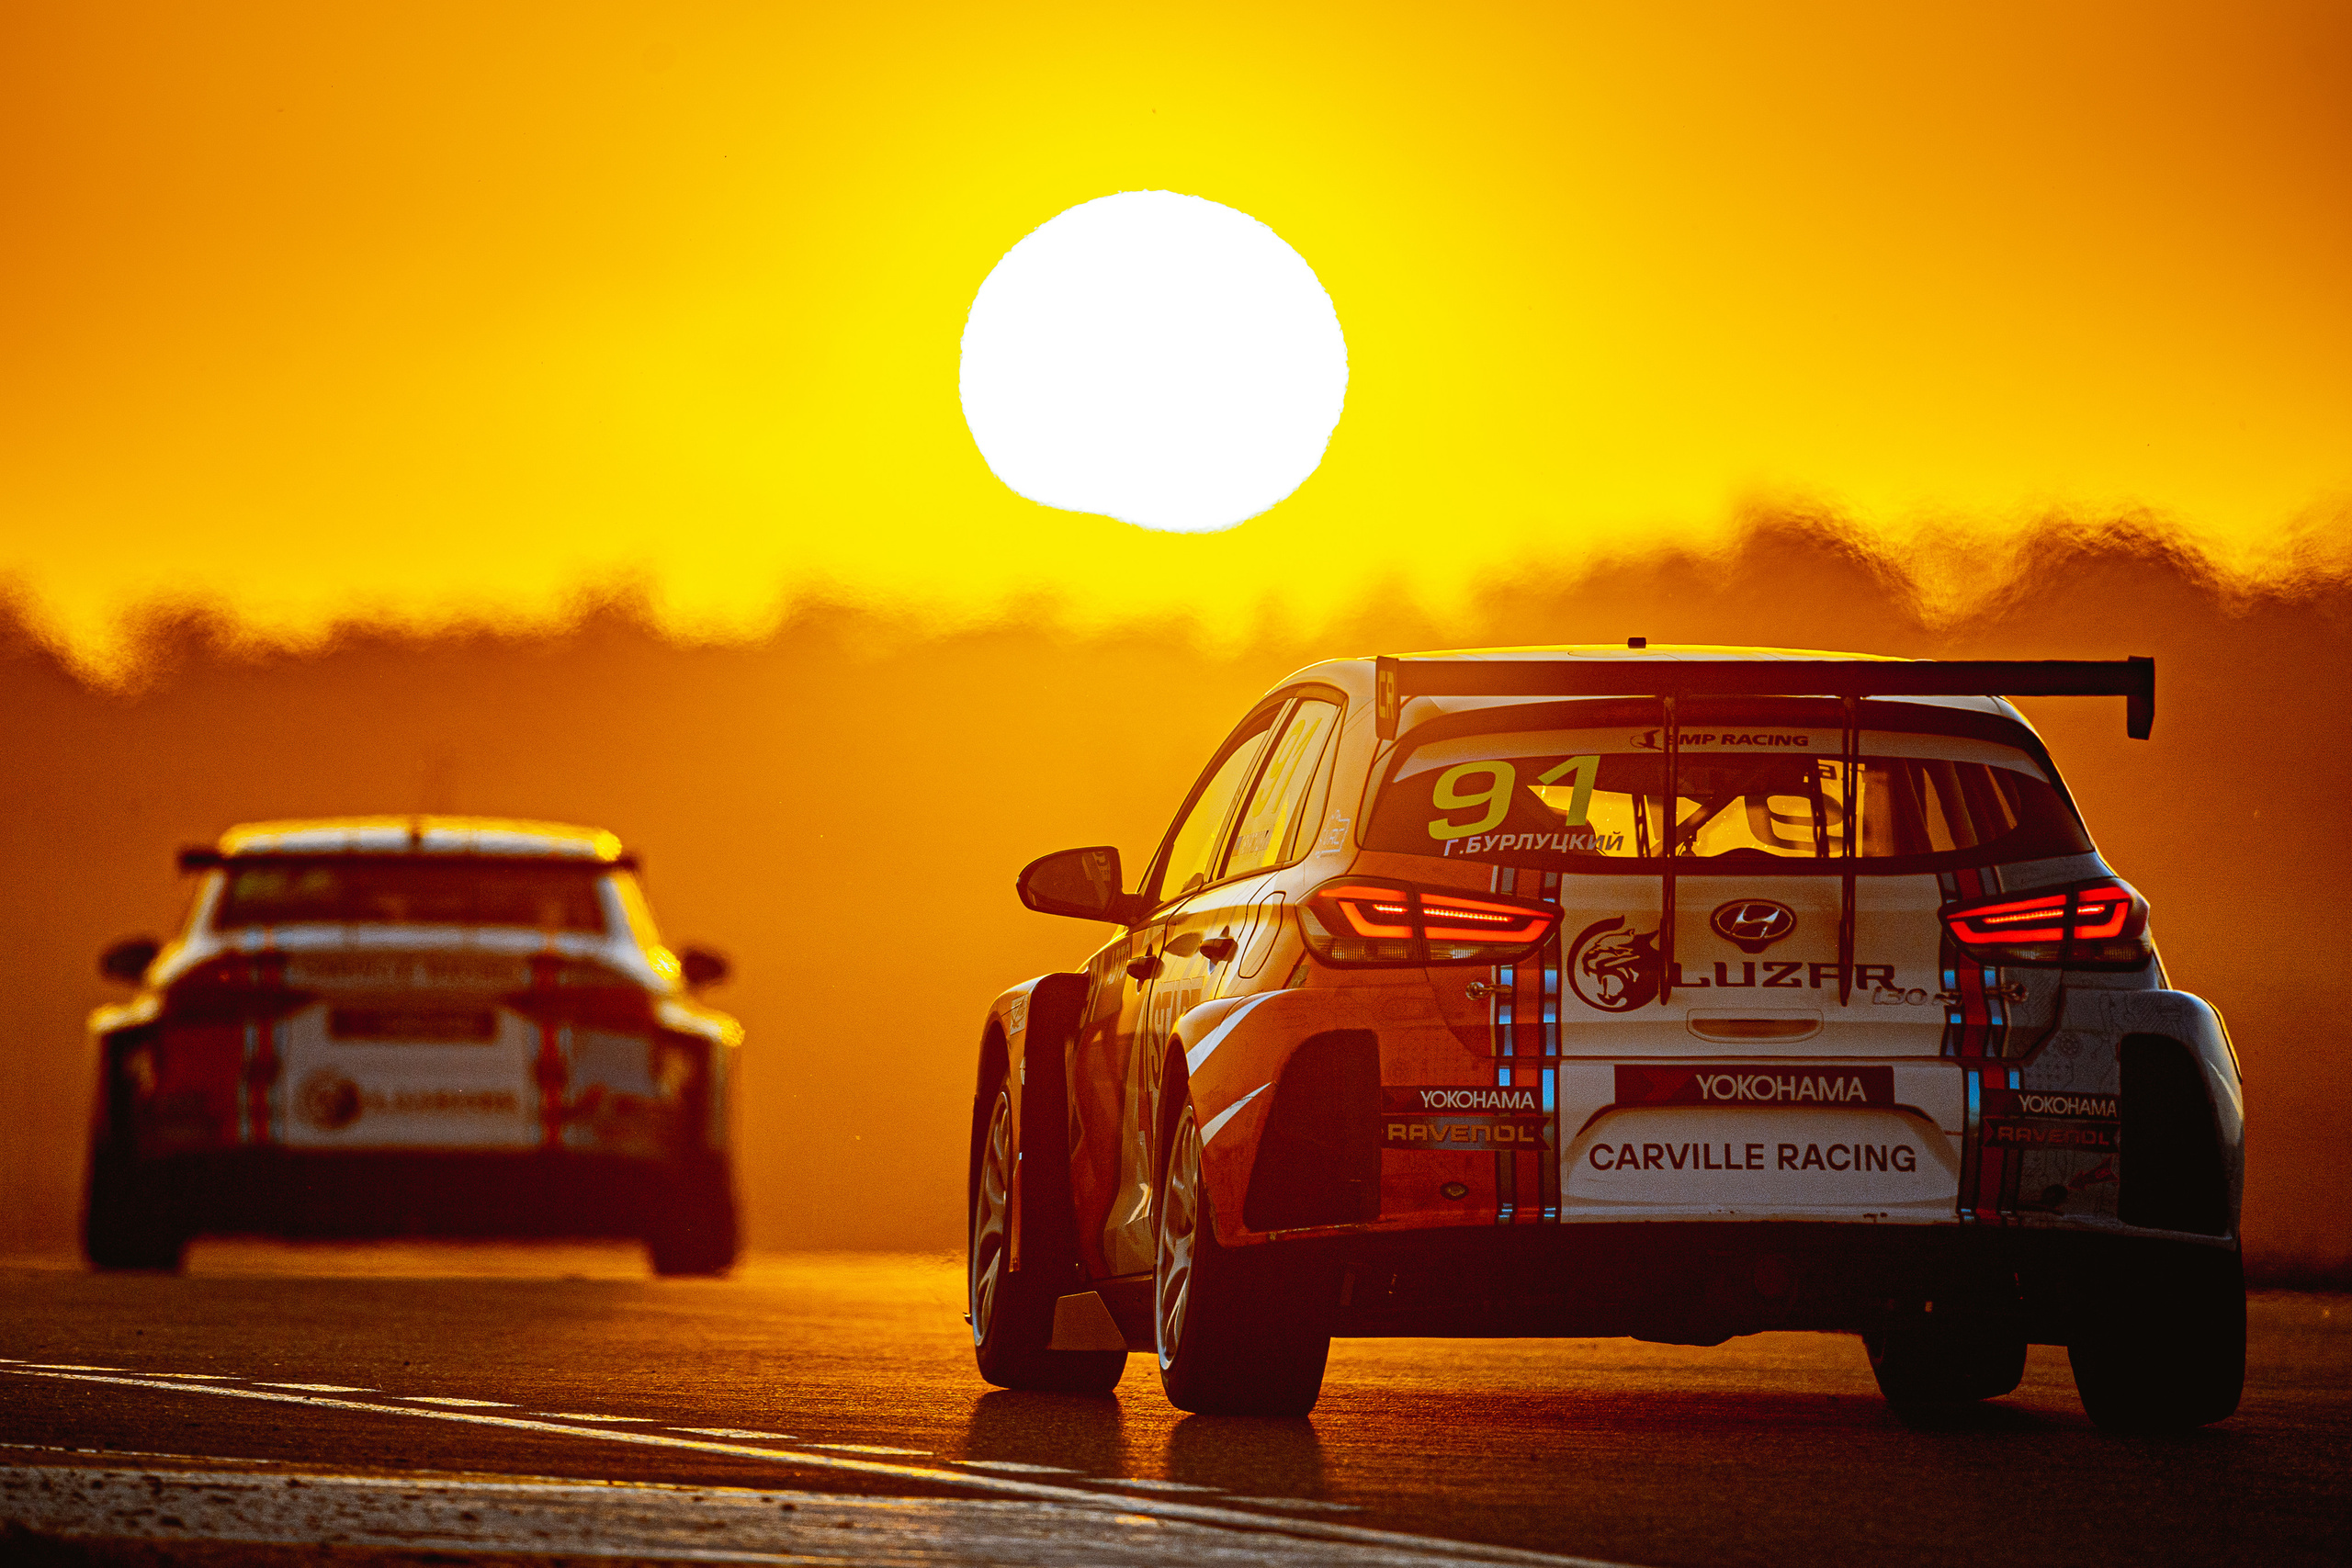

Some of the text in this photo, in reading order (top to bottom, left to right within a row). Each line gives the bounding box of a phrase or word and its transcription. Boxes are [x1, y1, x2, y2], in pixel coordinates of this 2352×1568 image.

[1721, 734, 1809, 747] RACING
[1429, 755, 1601, 840] 91
[1443, 830, 1624, 856] Г.БУРЛУЦКИЙ
[1419, 1089, 1536, 1110] YOKOHAMA
[1695, 1074, 1868, 1102] YOKOHAMA
[2018, 1094, 2118, 1118] YOKOHAMA
[1387, 1122, 1535, 1143] RAVENOL
[1997, 1125, 2110, 1146] RAVENOL
[1589, 1143, 1917, 1173] CARVILLE RACING
